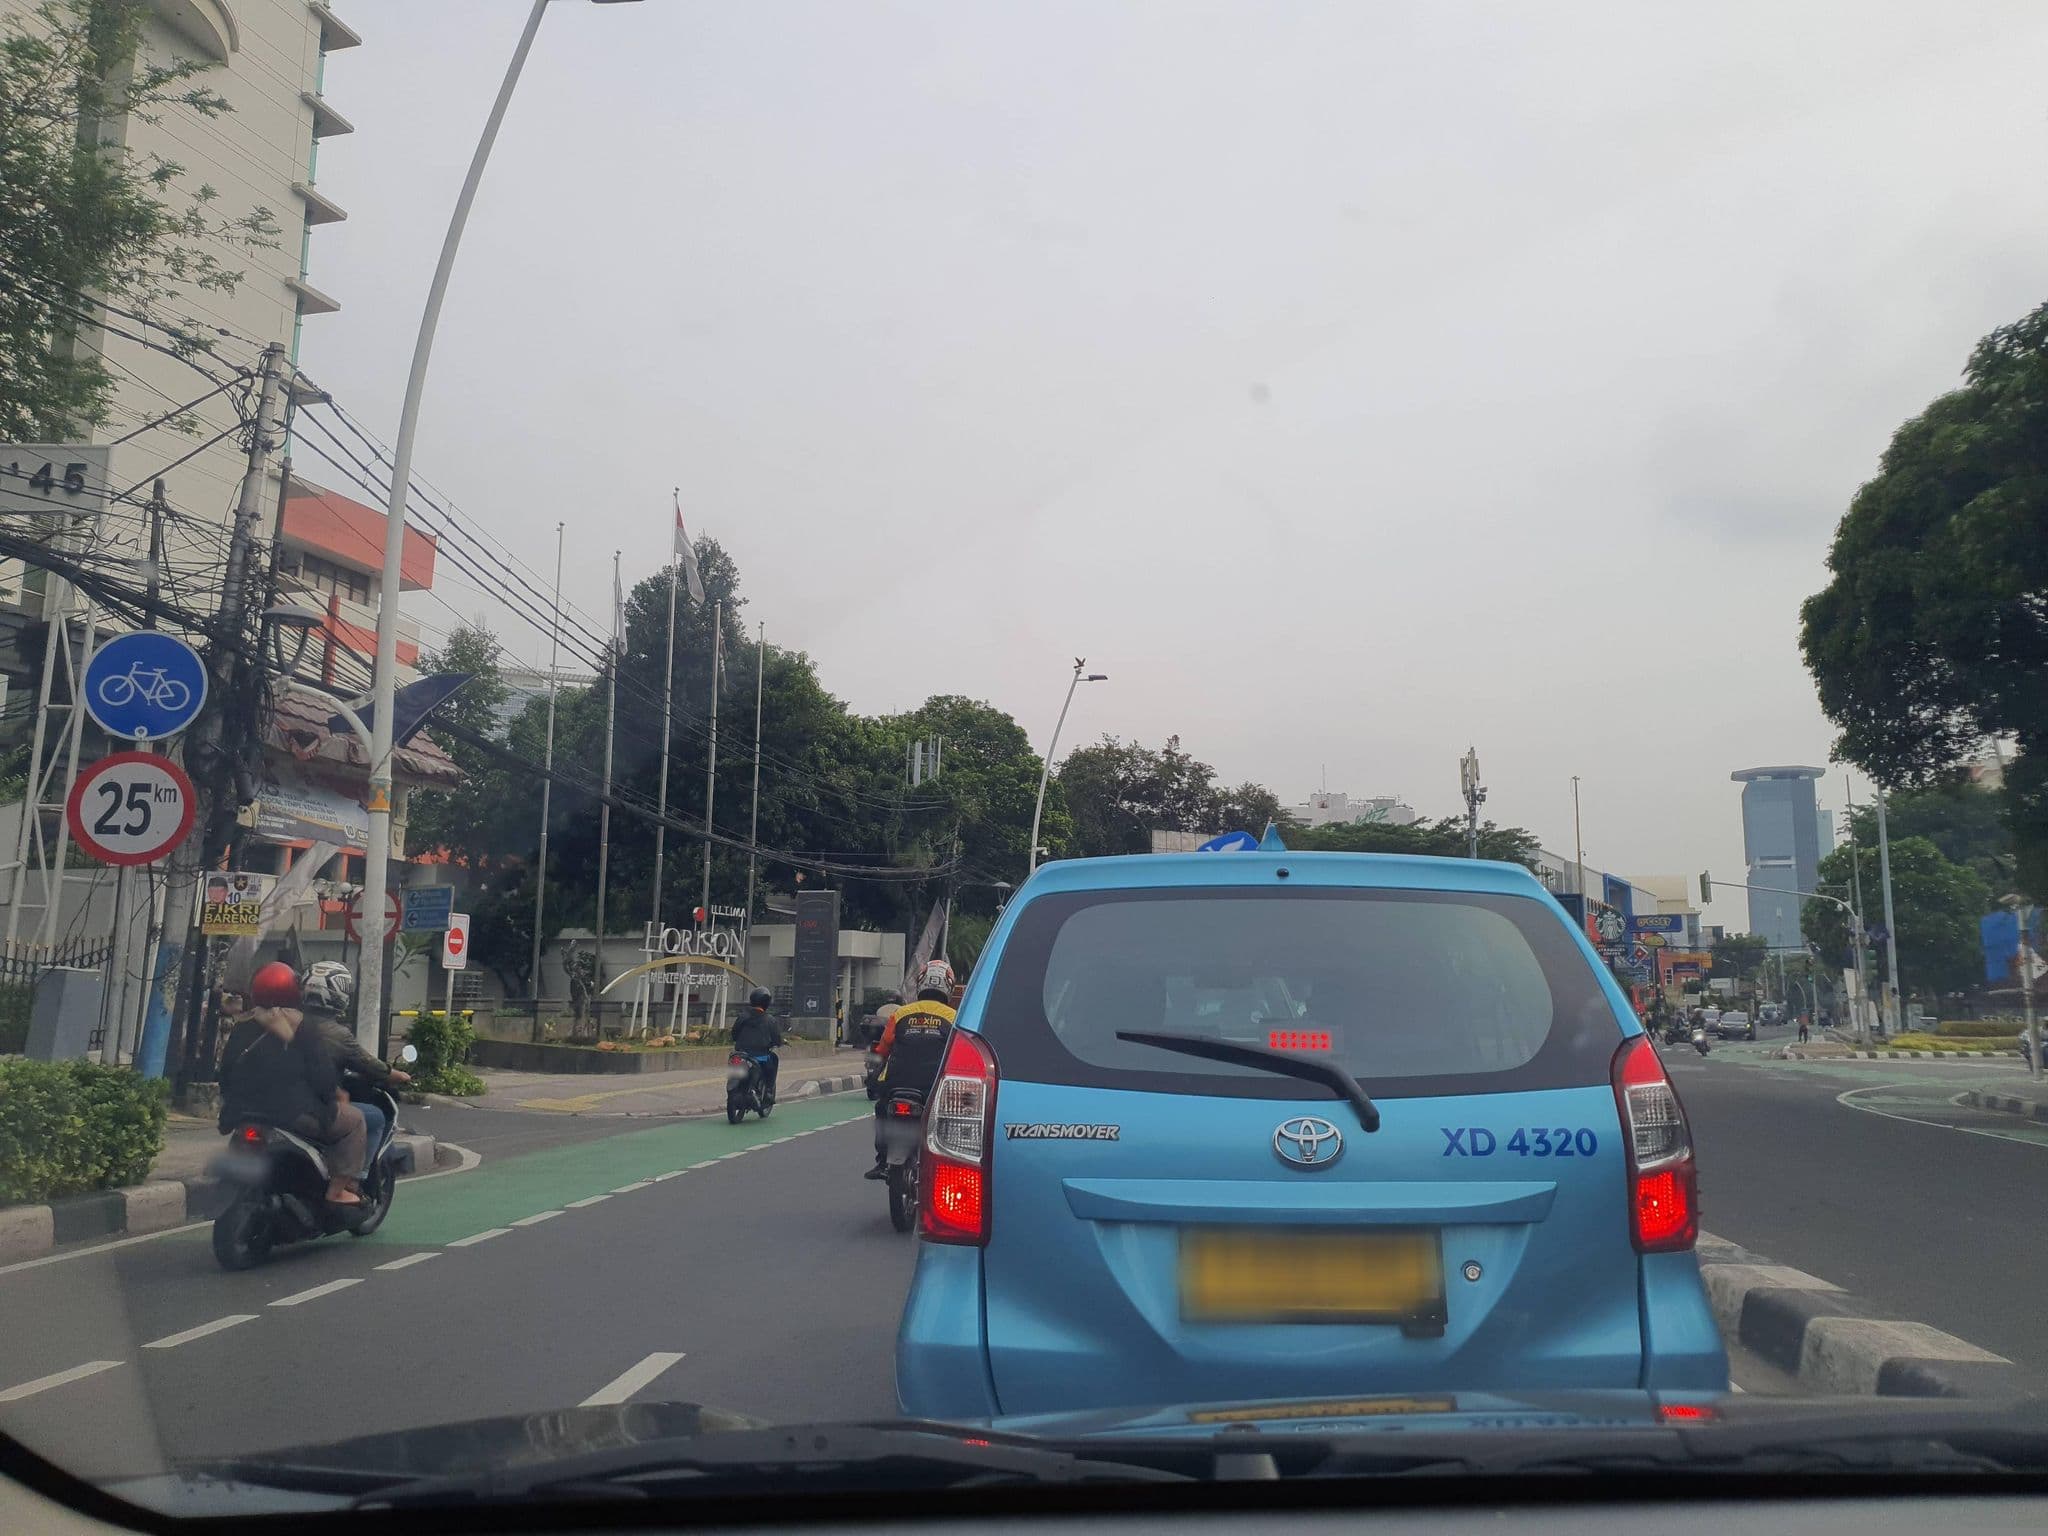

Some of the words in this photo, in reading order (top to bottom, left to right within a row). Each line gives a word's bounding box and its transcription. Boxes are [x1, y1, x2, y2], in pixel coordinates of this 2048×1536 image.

[94, 781, 152, 836] 25
[154, 783, 178, 803] km
[205, 903, 259, 914] FIKRI
[711, 904, 747, 918] ULTIMA
[645, 921, 747, 957] HORISON
[1004, 1123, 1120, 1140] TRANSMOVER
[1440, 1127, 1497, 1157] XD
[1506, 1127, 1598, 1157] 4320
